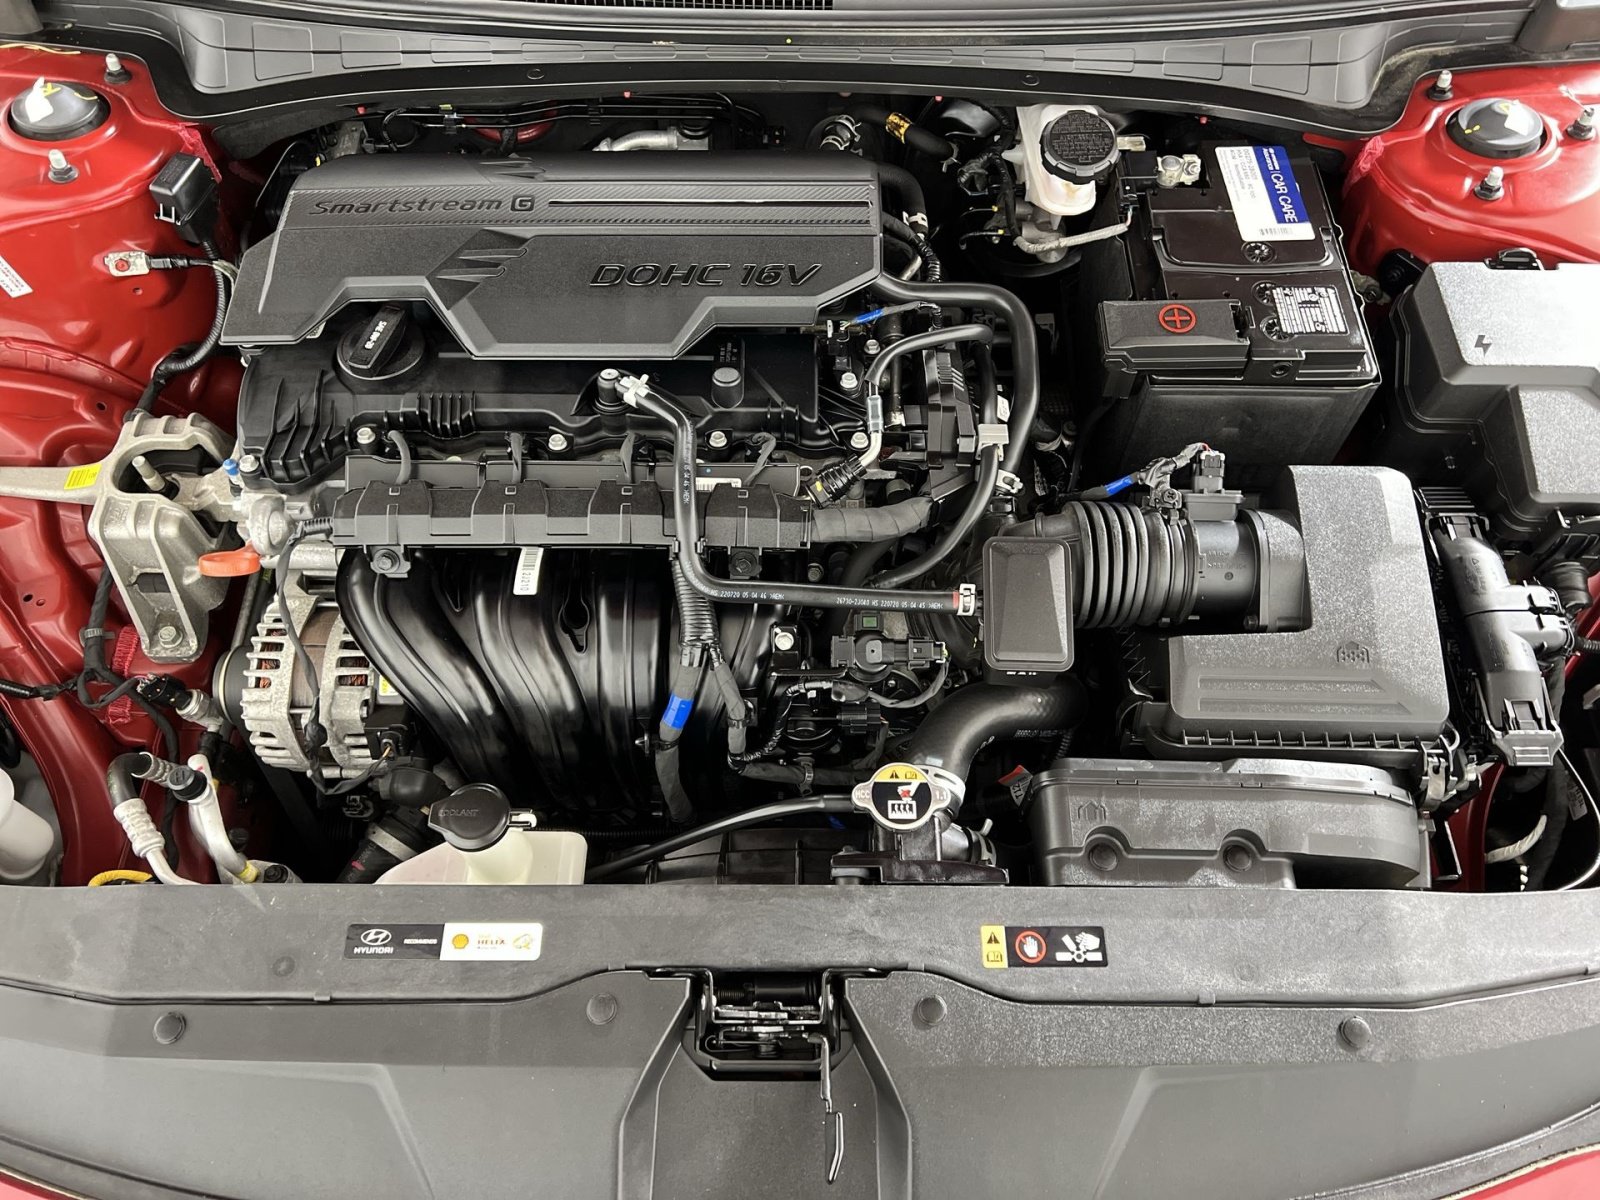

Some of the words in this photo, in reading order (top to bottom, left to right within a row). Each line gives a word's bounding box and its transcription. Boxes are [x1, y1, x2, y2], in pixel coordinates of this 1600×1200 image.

[1271, 173, 1288, 194] CAR
[309, 198, 502, 215] Smartstream
[512, 195, 534, 211] G
[1278, 195, 1298, 223] CARE
[590, 264, 731, 286] DOHC
[740, 264, 822, 286] 16V
[855, 789, 871, 799] HCC
[935, 791, 947, 800] 1.1
[353, 946, 394, 954] HYUNDAI
